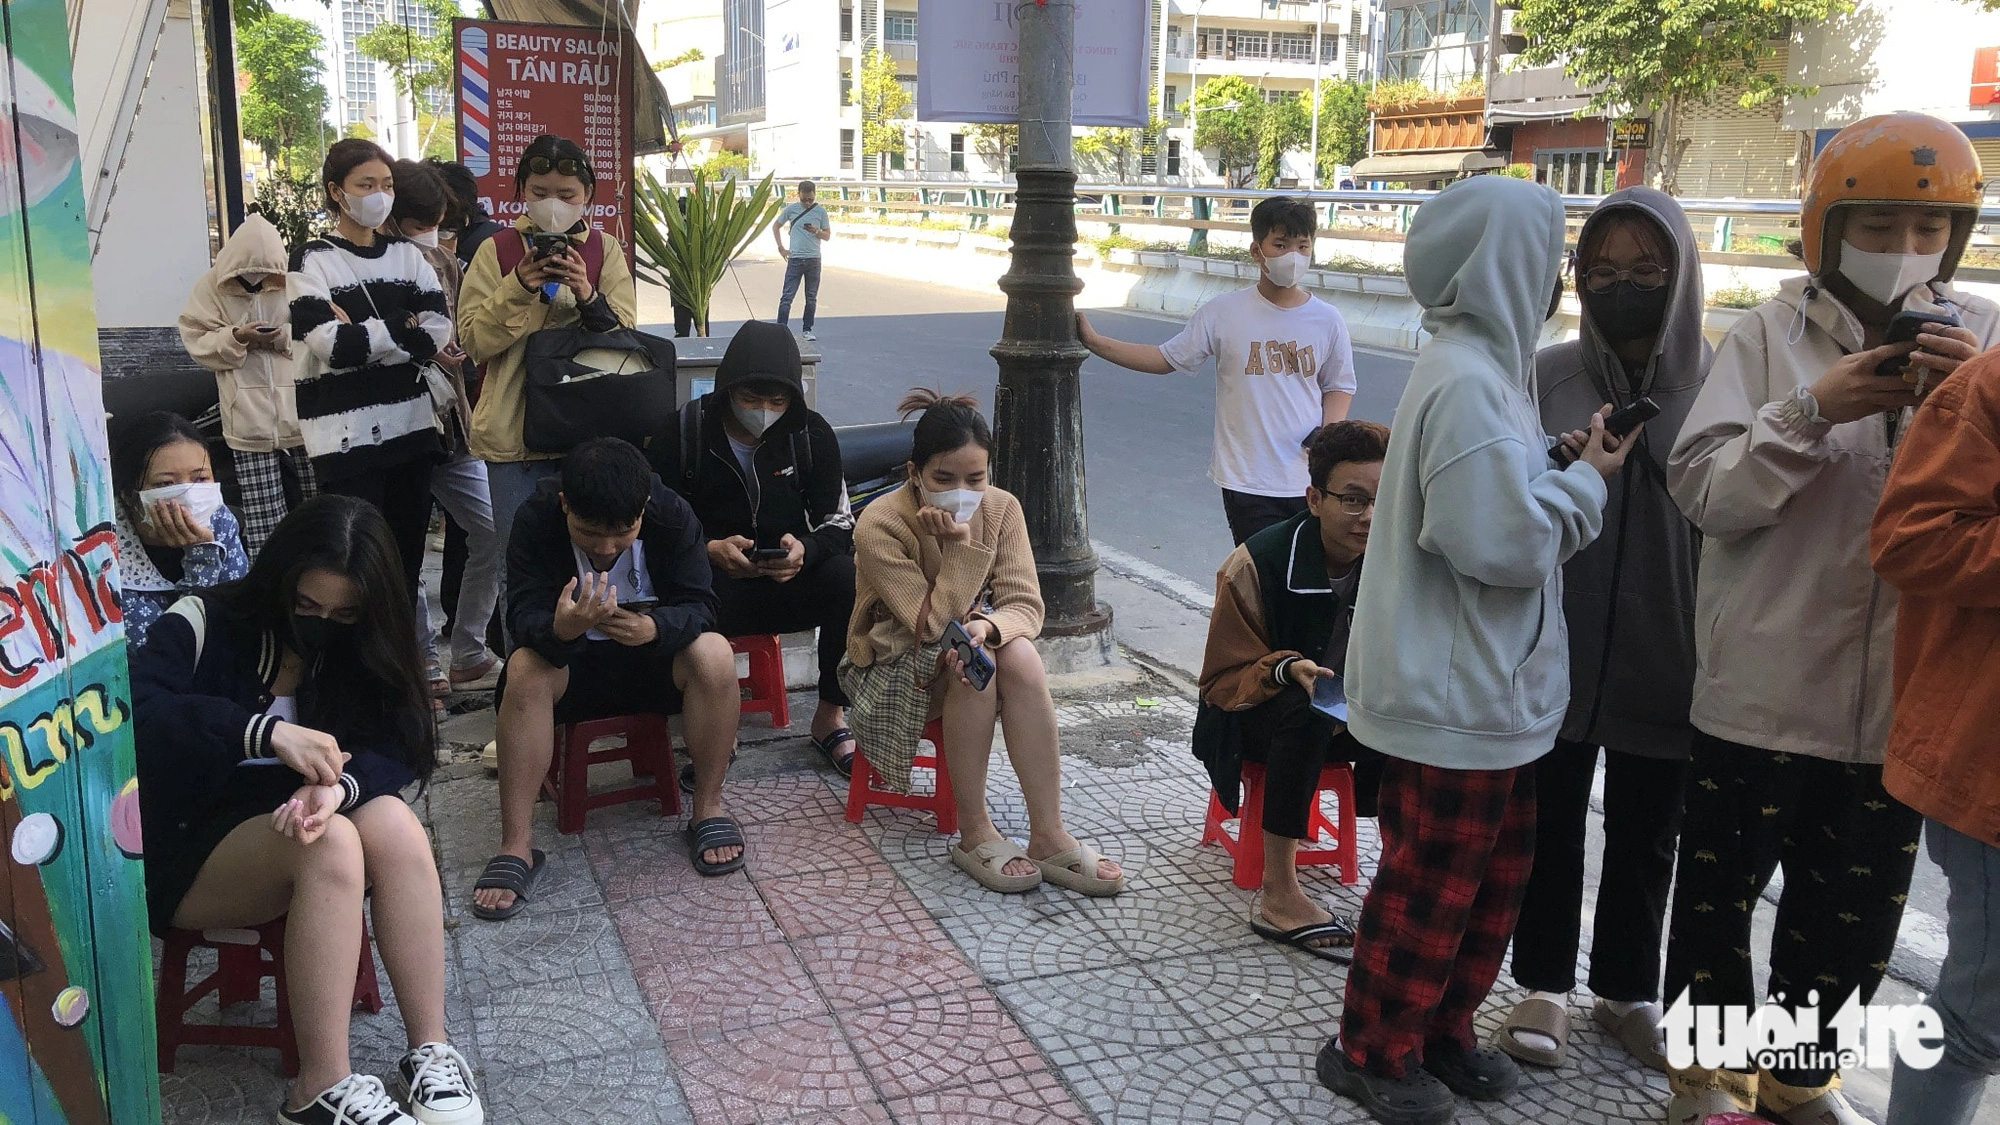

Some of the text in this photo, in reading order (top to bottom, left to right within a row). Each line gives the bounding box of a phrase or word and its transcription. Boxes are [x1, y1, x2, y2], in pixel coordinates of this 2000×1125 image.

[496, 33, 620, 57] BEAUTY SALON
[506, 55, 611, 86] TẤN RÂU
[496, 88, 513, 98] 남자
[514, 89, 531, 99] 이발
[584, 94, 612, 102] 80000
[497, 99, 513, 109] 면도
[584, 105, 612, 113] 50000
[497, 111, 513, 121] 귀지
[584, 116, 612, 125] 80000
[497, 123, 514, 132] 남자
[515, 123, 547, 134] 머리감기
[497, 134, 514, 143] 여자
[581, 204, 617, 217] MBO
[1244, 340, 1316, 378] AGNU
